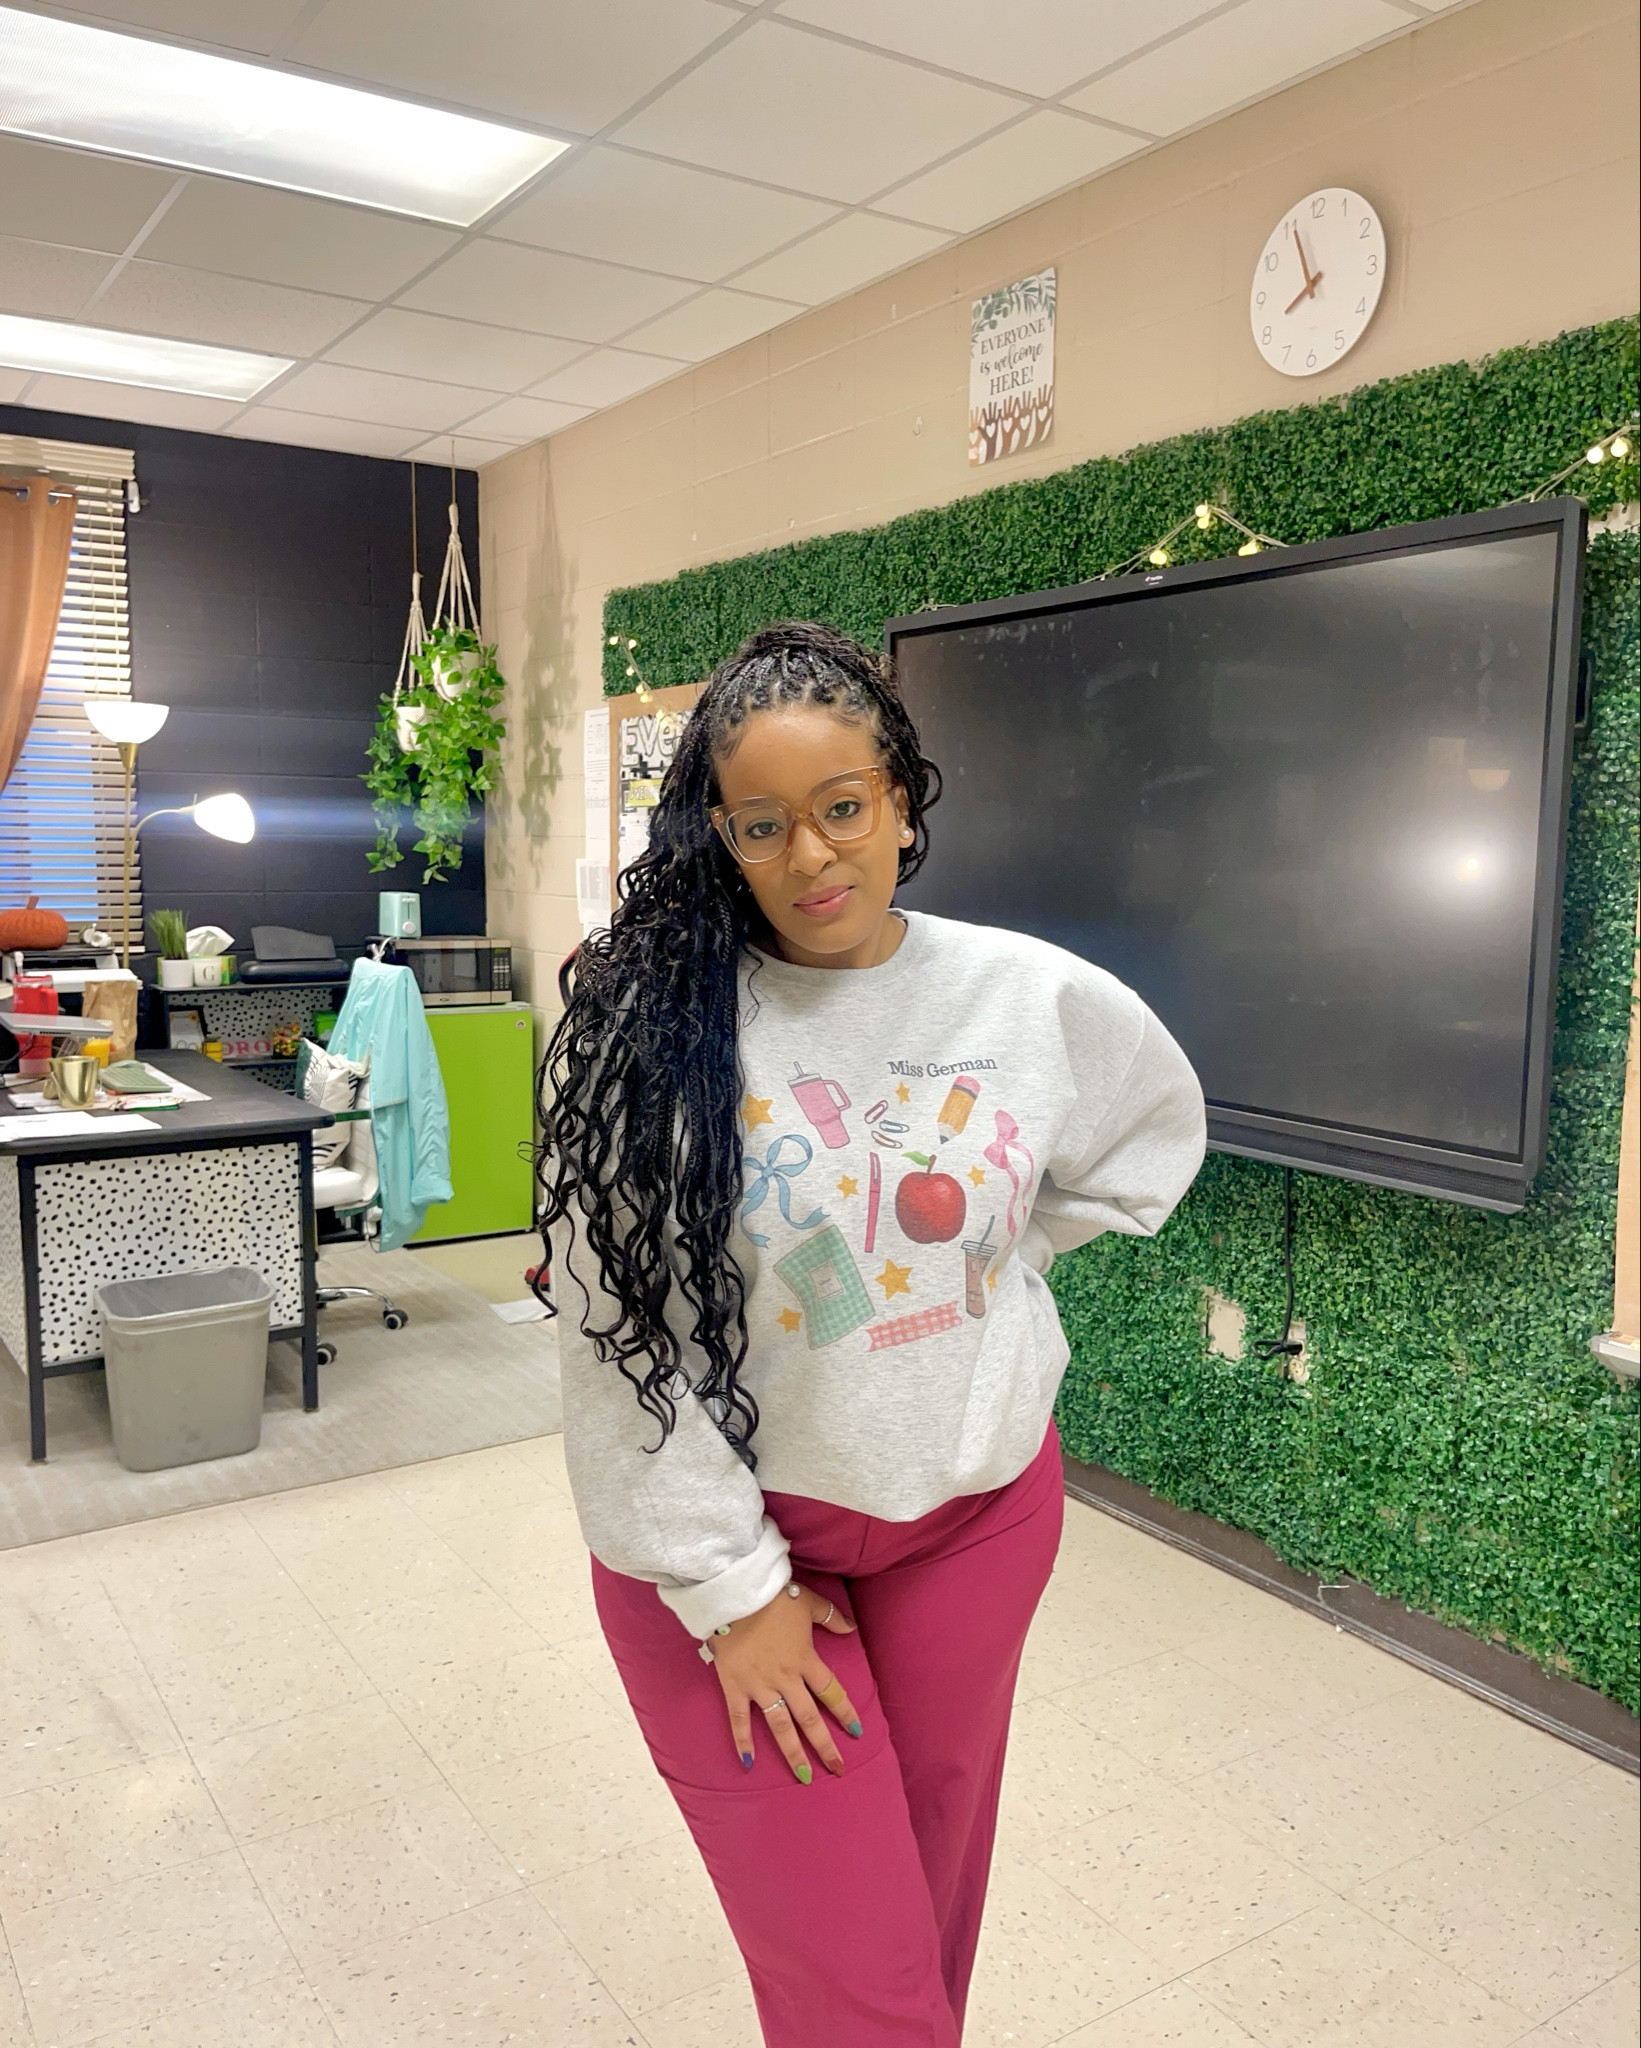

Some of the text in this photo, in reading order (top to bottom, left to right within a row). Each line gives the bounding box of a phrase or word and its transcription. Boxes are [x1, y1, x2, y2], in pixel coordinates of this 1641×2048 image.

[1311, 197, 1326, 218] 12
[1341, 198, 1347, 217] 1
[1283, 219, 1297, 240] 11
[1359, 217, 1371, 239] 2
[1264, 252, 1279, 273] 10
[1366, 254, 1378, 275] 3
[1256, 291, 1266, 311] 9
[1355, 296, 1366, 316] 4
[980, 317, 1046, 355] EVERYONE
[1262, 326, 1272, 345] 8
[1334, 330, 1345, 350] 5
[979, 342, 1043, 375] is welcome
[1282, 345, 1292, 366] 7
[1306, 349, 1317, 367] 6
[989, 365, 1035, 396] HERE!
[203, 965, 215, 981] G
[887, 1058, 998, 1078] Miss German
